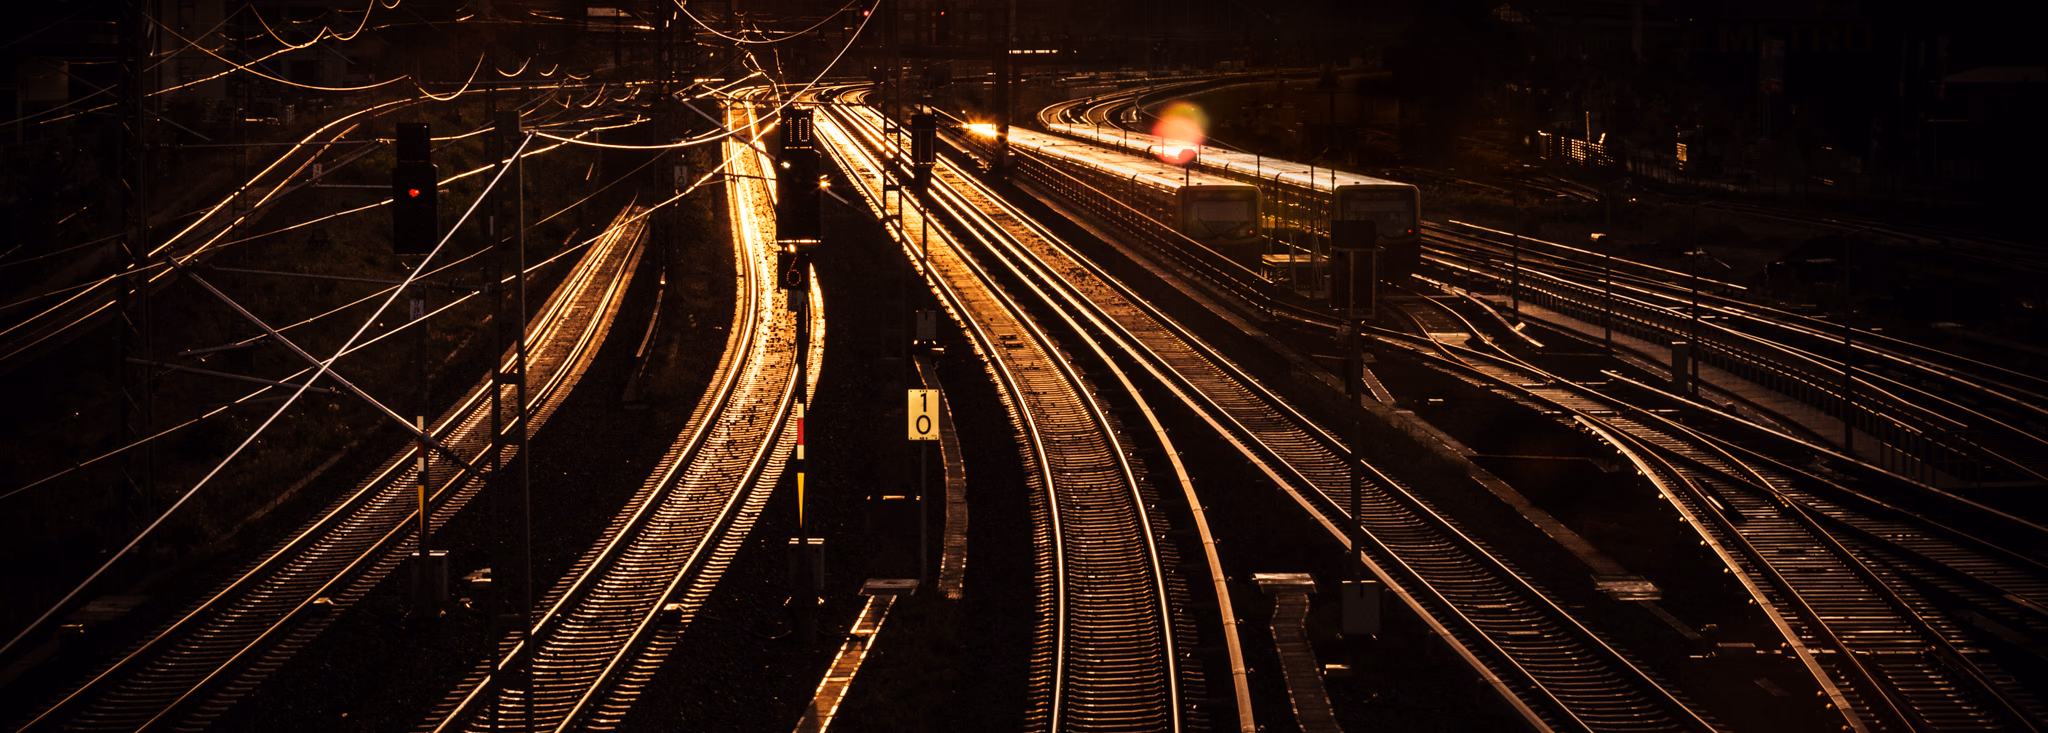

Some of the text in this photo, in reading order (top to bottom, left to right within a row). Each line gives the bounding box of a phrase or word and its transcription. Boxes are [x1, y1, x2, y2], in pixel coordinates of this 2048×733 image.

[1718, 24, 1875, 53] MTRO
[786, 116, 810, 142] 10
[786, 257, 801, 286] 6
[920, 392, 927, 412] 1
[916, 415, 931, 435] 0
